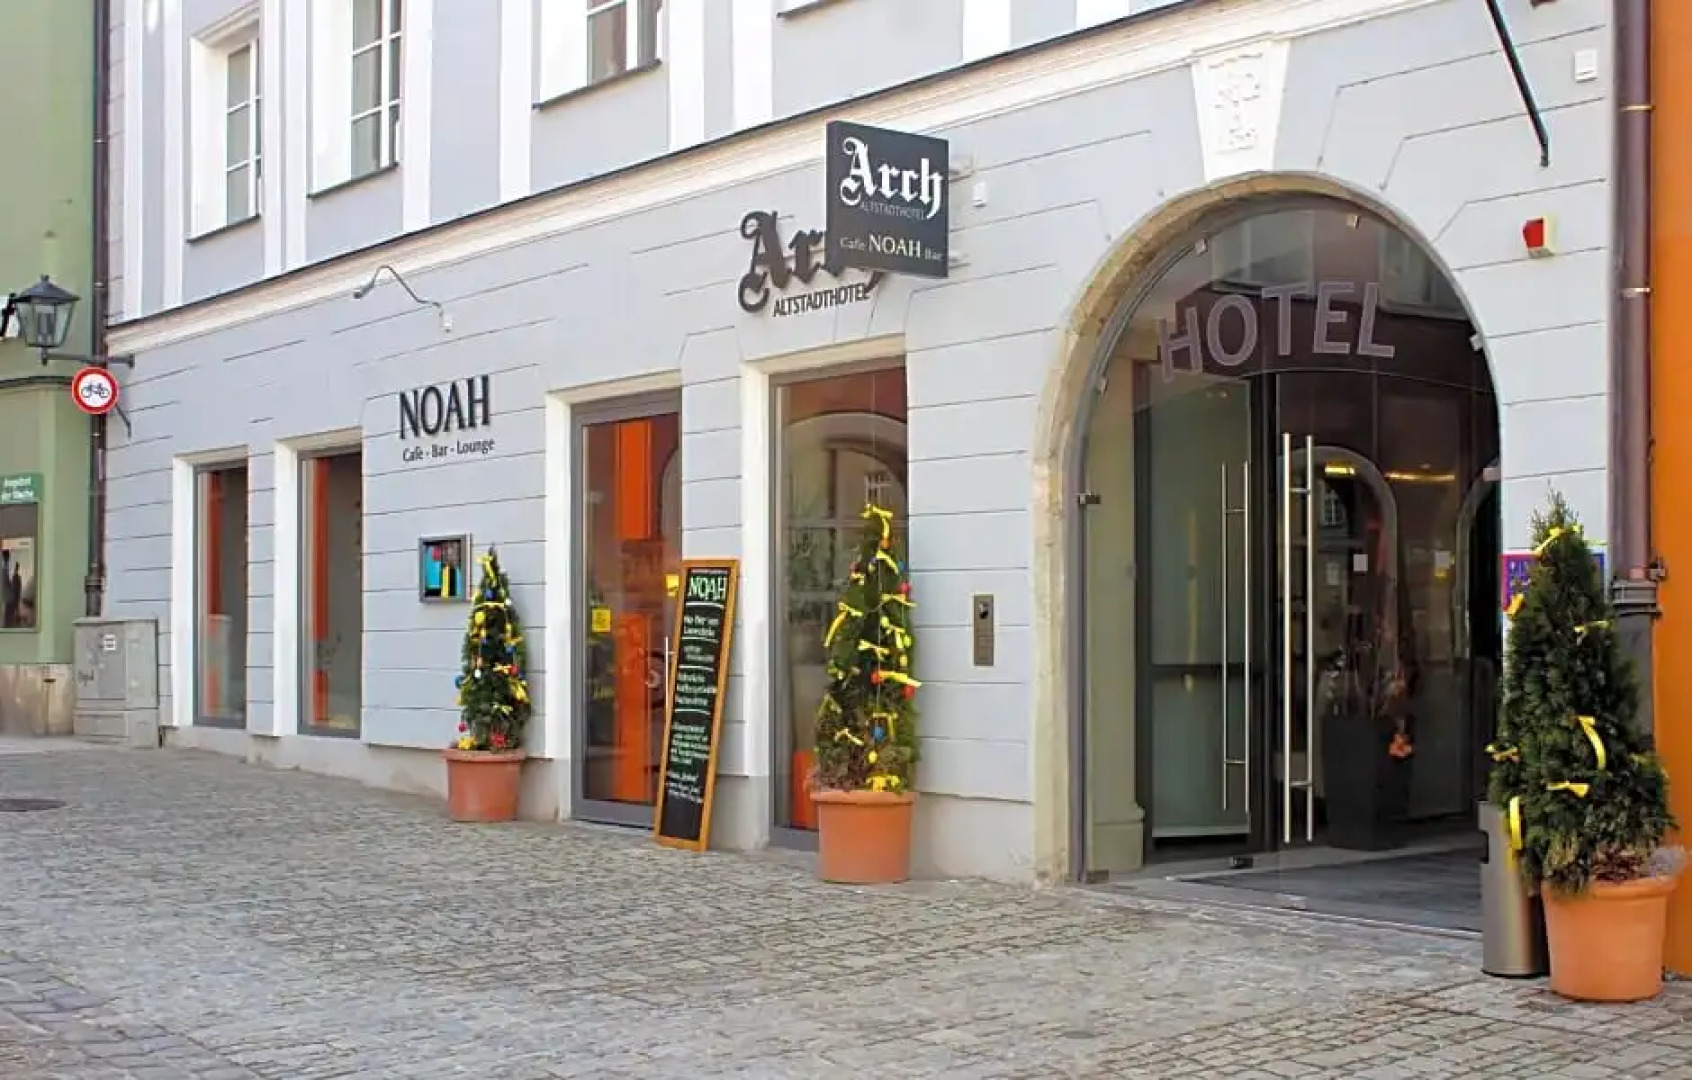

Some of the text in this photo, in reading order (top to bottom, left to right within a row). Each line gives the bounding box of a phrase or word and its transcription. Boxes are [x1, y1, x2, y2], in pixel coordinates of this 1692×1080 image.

[840, 136, 943, 219] Arch
[860, 201, 926, 220] ALTSTADTHOTEL
[868, 233, 921, 258] NOAH
[773, 283, 869, 317] ALTSTADTHOTEL
[1158, 281, 1395, 383] HOTEL
[400, 374, 490, 440] NOAH
[431, 444, 448, 458] Bar
[456, 438, 495, 455] Lounge
[687, 576, 727, 600] NOAH
